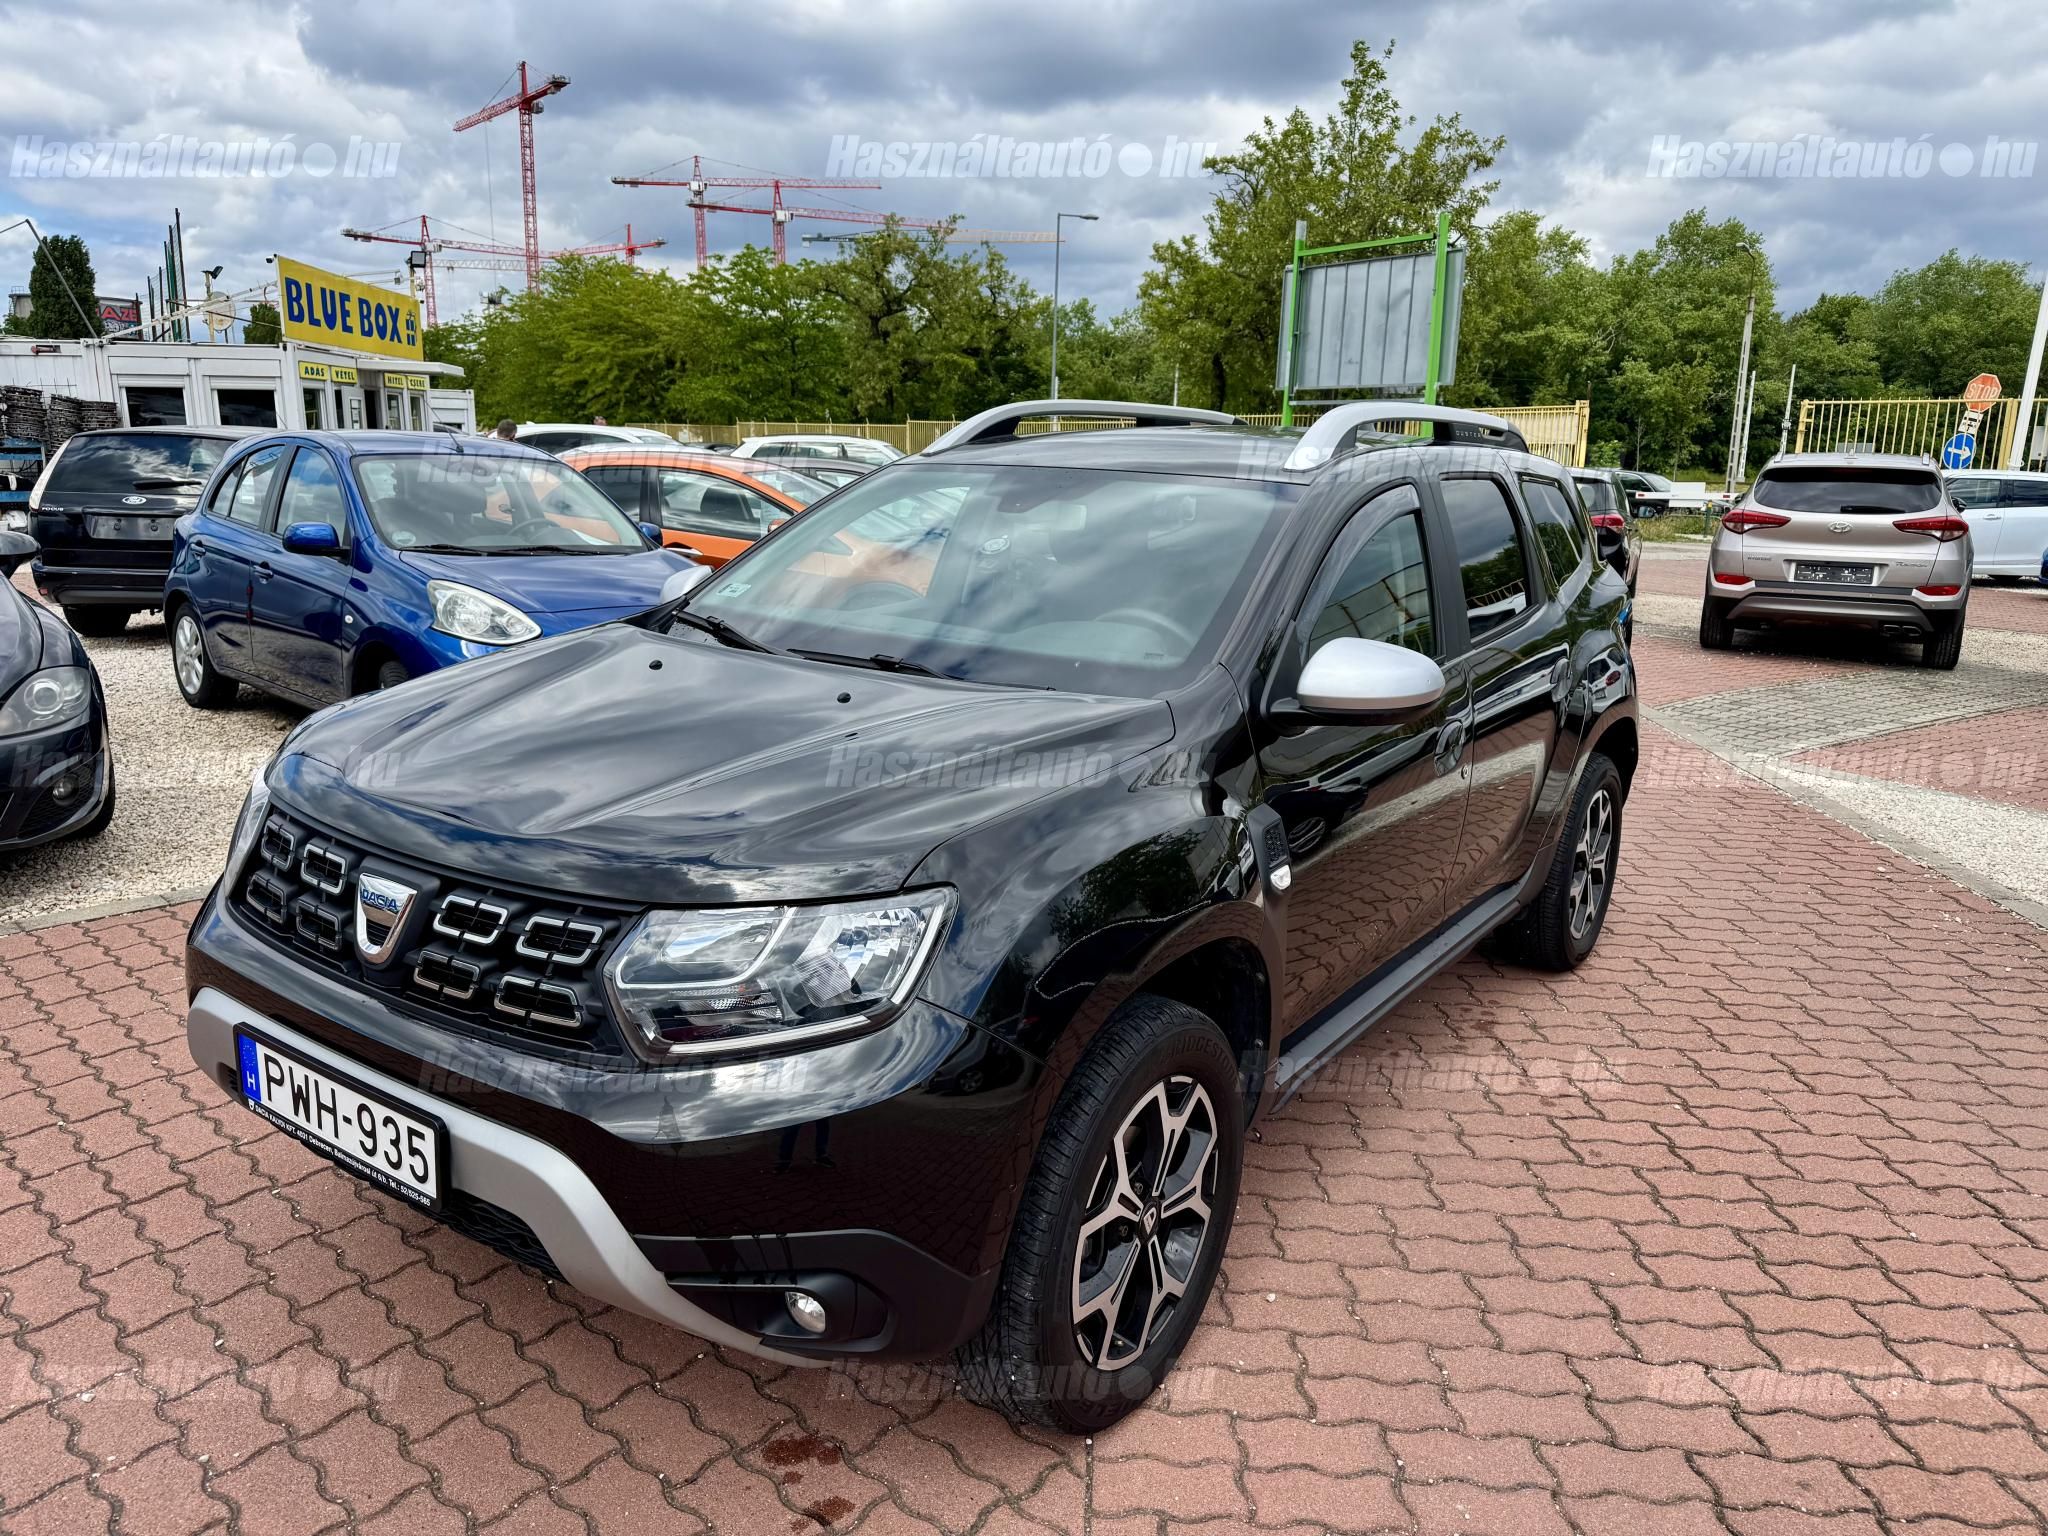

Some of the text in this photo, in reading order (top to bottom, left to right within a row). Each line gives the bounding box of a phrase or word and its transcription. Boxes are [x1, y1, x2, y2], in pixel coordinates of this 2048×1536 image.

[285, 276, 402, 344] BLUE BOX
[1966, 383, 1998, 399] STOP
[362, 888, 398, 911] DACIA
[246, 1070, 257, 1091] H
[263, 1053, 429, 1185] PWH-935
